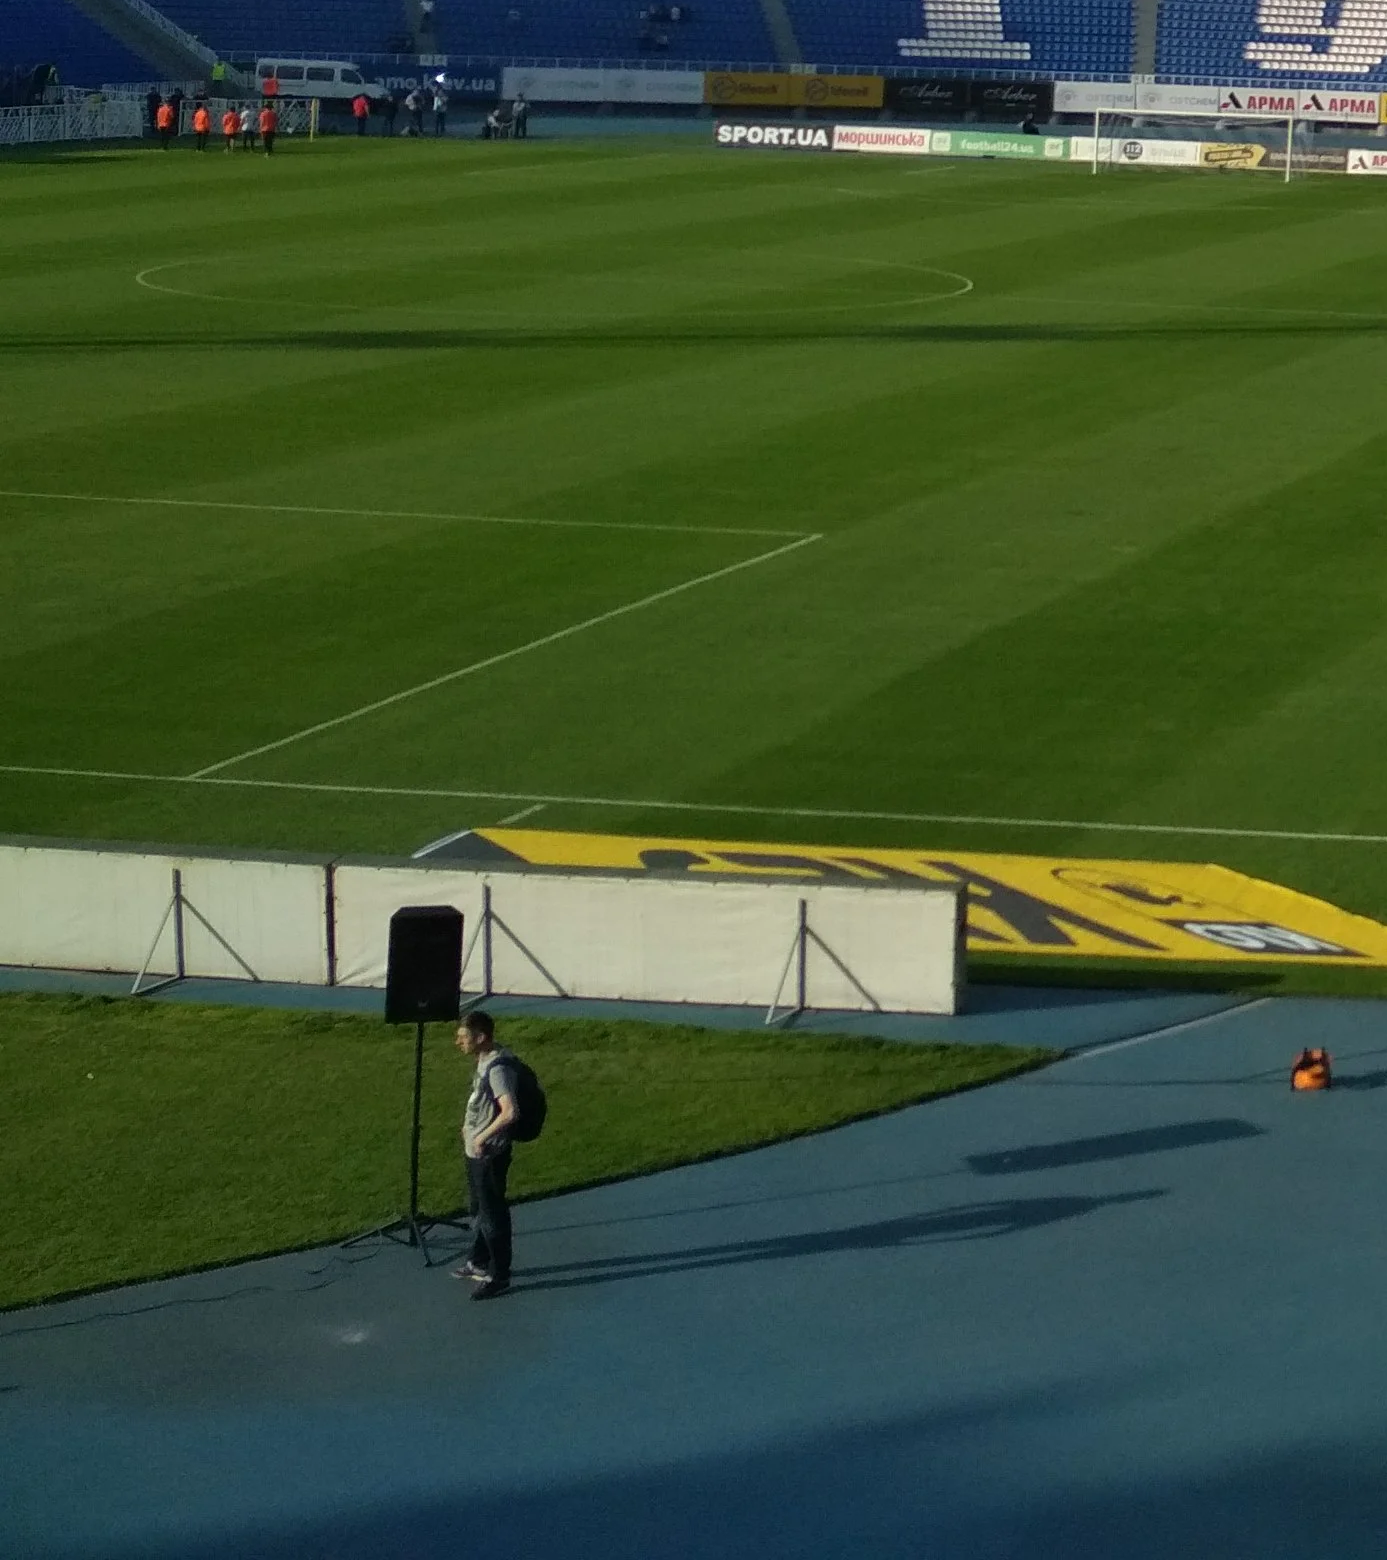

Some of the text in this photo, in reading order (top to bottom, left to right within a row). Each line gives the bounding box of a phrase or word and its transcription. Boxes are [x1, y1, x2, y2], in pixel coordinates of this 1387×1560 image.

[374, 73, 497, 92] amo.kev.ua
[717, 124, 829, 147] SPORT.UA
[836, 129, 926, 148] моршинська
